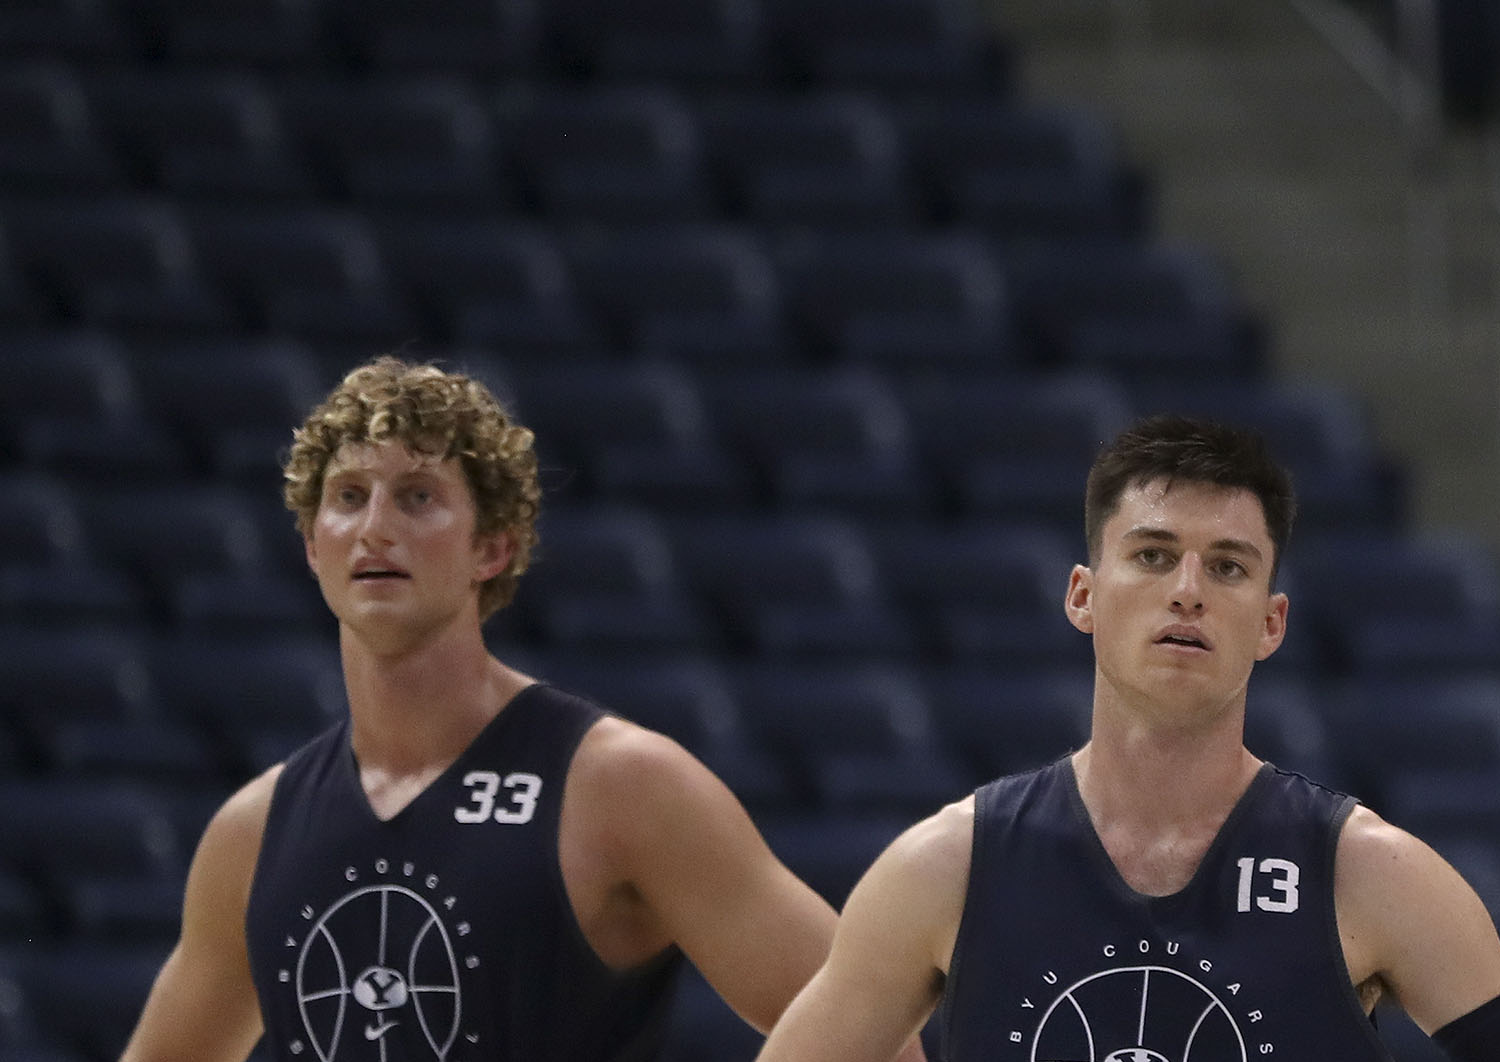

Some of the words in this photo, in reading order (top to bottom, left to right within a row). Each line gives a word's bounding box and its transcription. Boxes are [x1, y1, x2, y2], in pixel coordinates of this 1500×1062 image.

[454, 771, 543, 825] 33
[1237, 857, 1301, 914] 13
[279, 905, 314, 982] BYU
[345, 858, 480, 969] COUGARS
[363, 972, 400, 1004] Y
[1010, 971, 1057, 1043] BYU
[1104, 939, 1273, 1055] COUGARS
